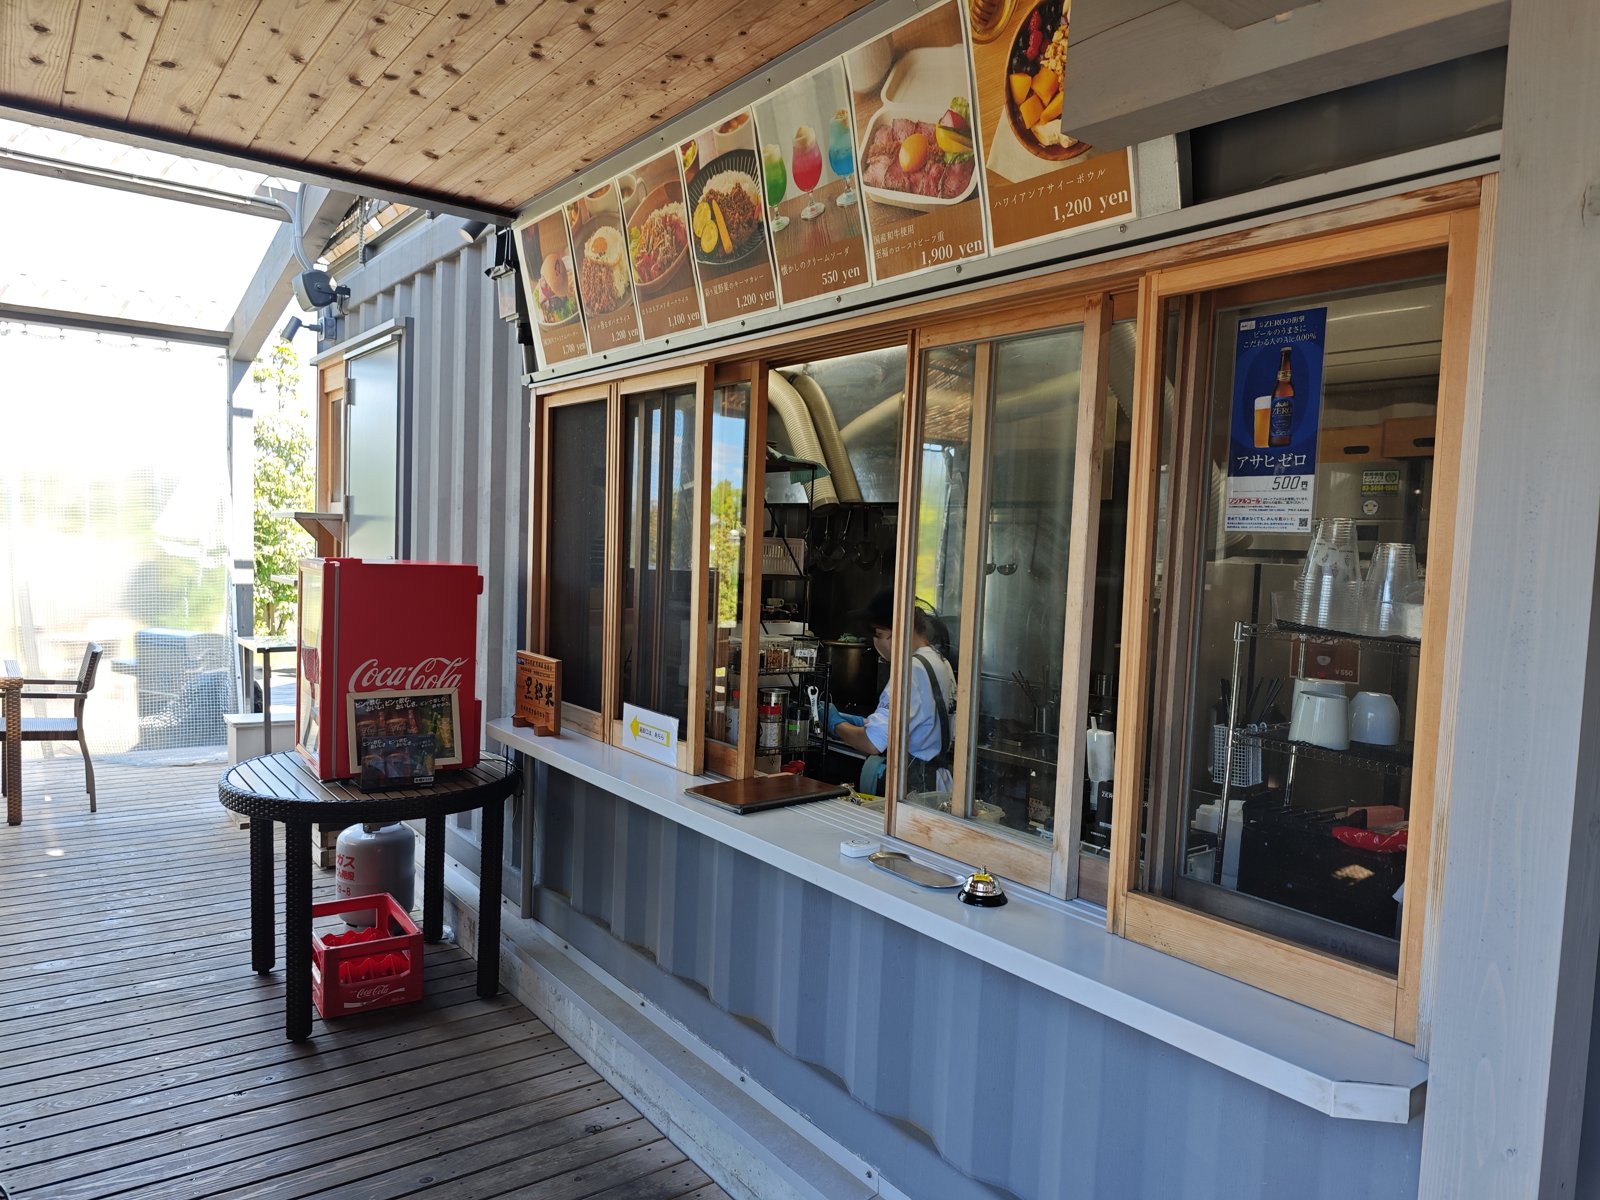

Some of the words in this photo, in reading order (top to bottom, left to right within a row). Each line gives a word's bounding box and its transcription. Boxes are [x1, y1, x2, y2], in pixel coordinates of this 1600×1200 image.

[994, 168, 1106, 209] ハワイアンアサイーボウル
[1053, 196, 1092, 222] 1,200
[1100, 189, 1129, 213] yen
[874, 224, 915, 246] 国産和牛使用
[875, 231, 945, 259] 至福のローストビーフ重
[781, 246, 850, 276] 懐かしのクリームソーダ
[921, 244, 953, 267] 1,900
[959, 239, 983, 260] yen
[821, 269, 839, 285] 550
[842, 266, 860, 284] yen
[736, 293, 757, 310] 1,200
[759, 290, 775, 306] yen
[668, 312, 686, 329] 1,100
[687, 311, 700, 325] yen
[611, 329, 627, 342] 1,200
[627, 328, 639, 341] yen
[1254, 325, 1307, 339] ビールのうまさに
[1237, 454, 1275, 470] アサヒ
[1278, 452, 1307, 467] ゼロ
[1272, 475, 1301, 490] 500
[348, 657, 469, 693] Coca-Cola
